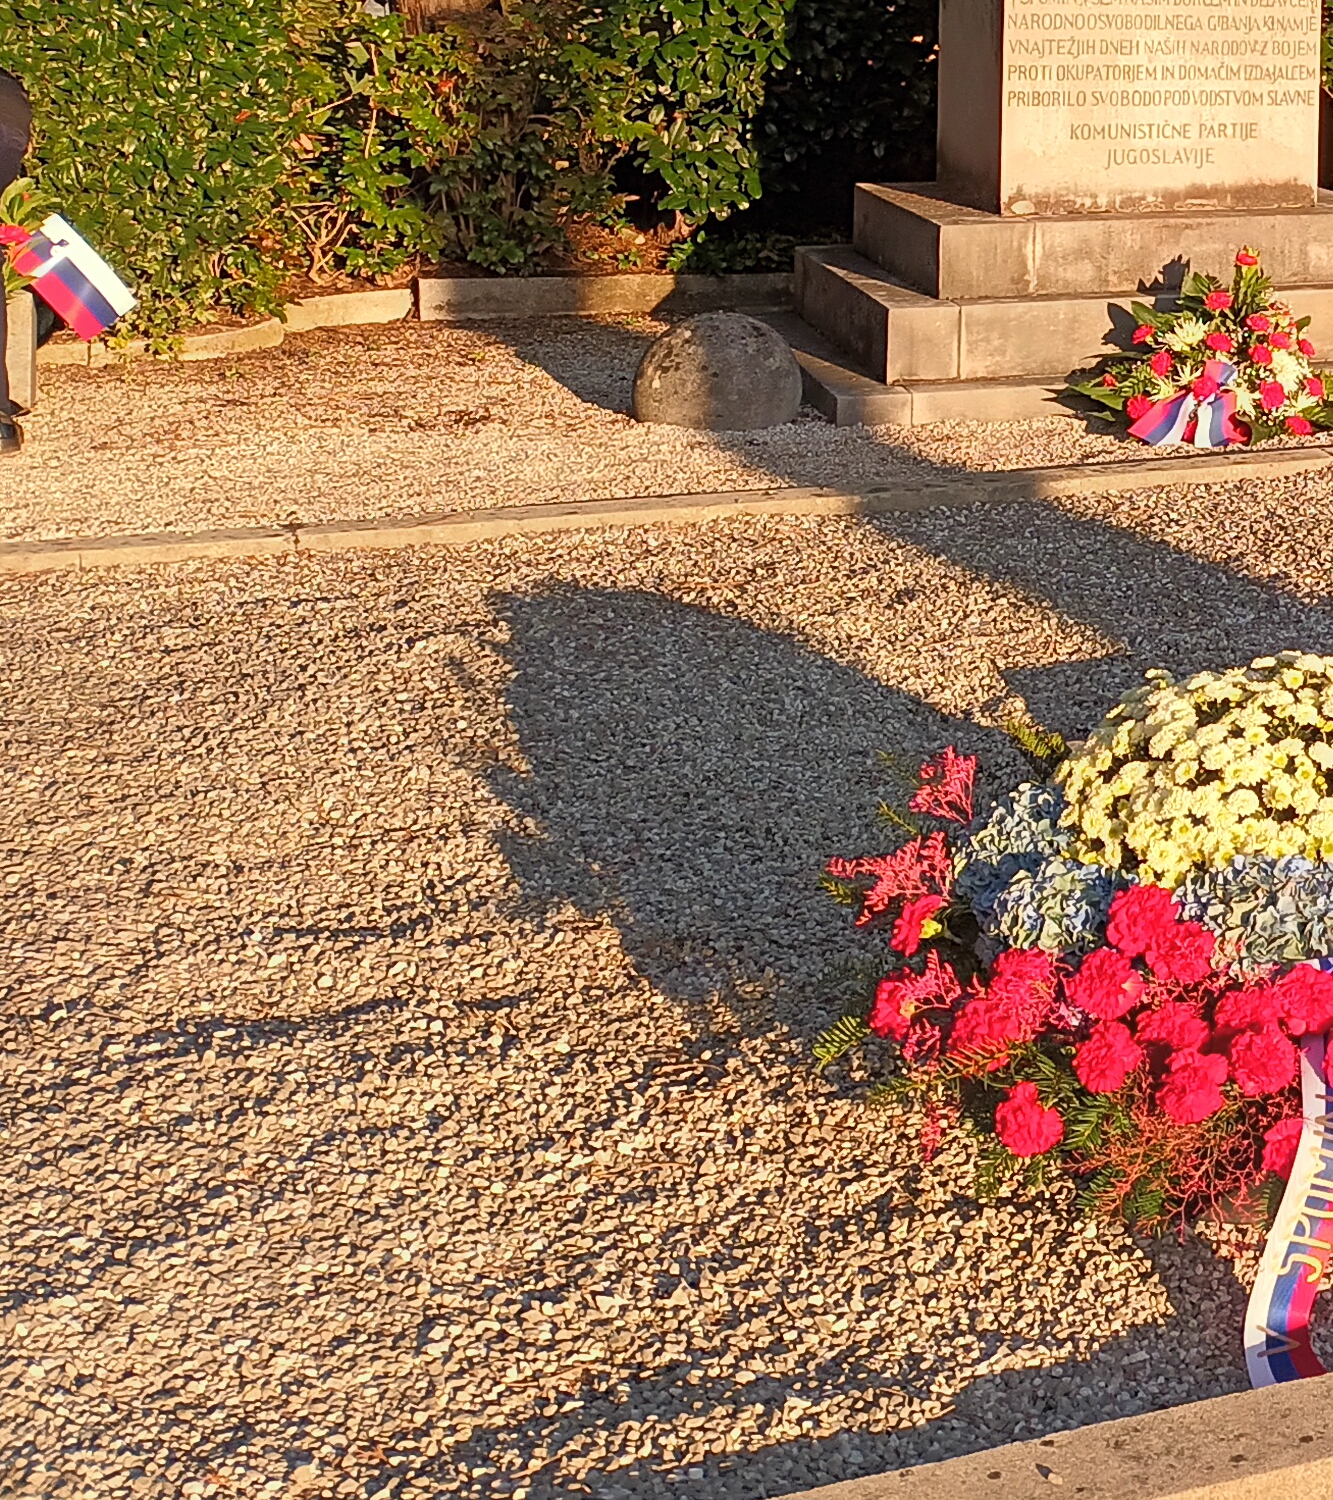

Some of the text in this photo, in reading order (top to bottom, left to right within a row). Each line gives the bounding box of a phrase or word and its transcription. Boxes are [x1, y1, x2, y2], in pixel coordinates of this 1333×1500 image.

[1007, 13, 1317, 36] NARODNOOSVOBODILNEGA GIBANJA KI NAM JE
[1009, 36, 1316, 59] V NAJTEŽJIH DNEH NAŠIH NARODOV Z BOJEM
[1008, 62, 1316, 84] PROTI OKUPATORJEM IN DOMAČIM IZDAJALCEM
[1008, 90, 1315, 107] PRIBORILO SVOBODO POD VODSTVOM SLAVNE
[1070, 120, 1258, 141] KOMUNISTIČNE PARTIJE
[1105, 148, 1215, 170] JUGOSLAVIJE
[1255, 1323, 1301, 1359] V
